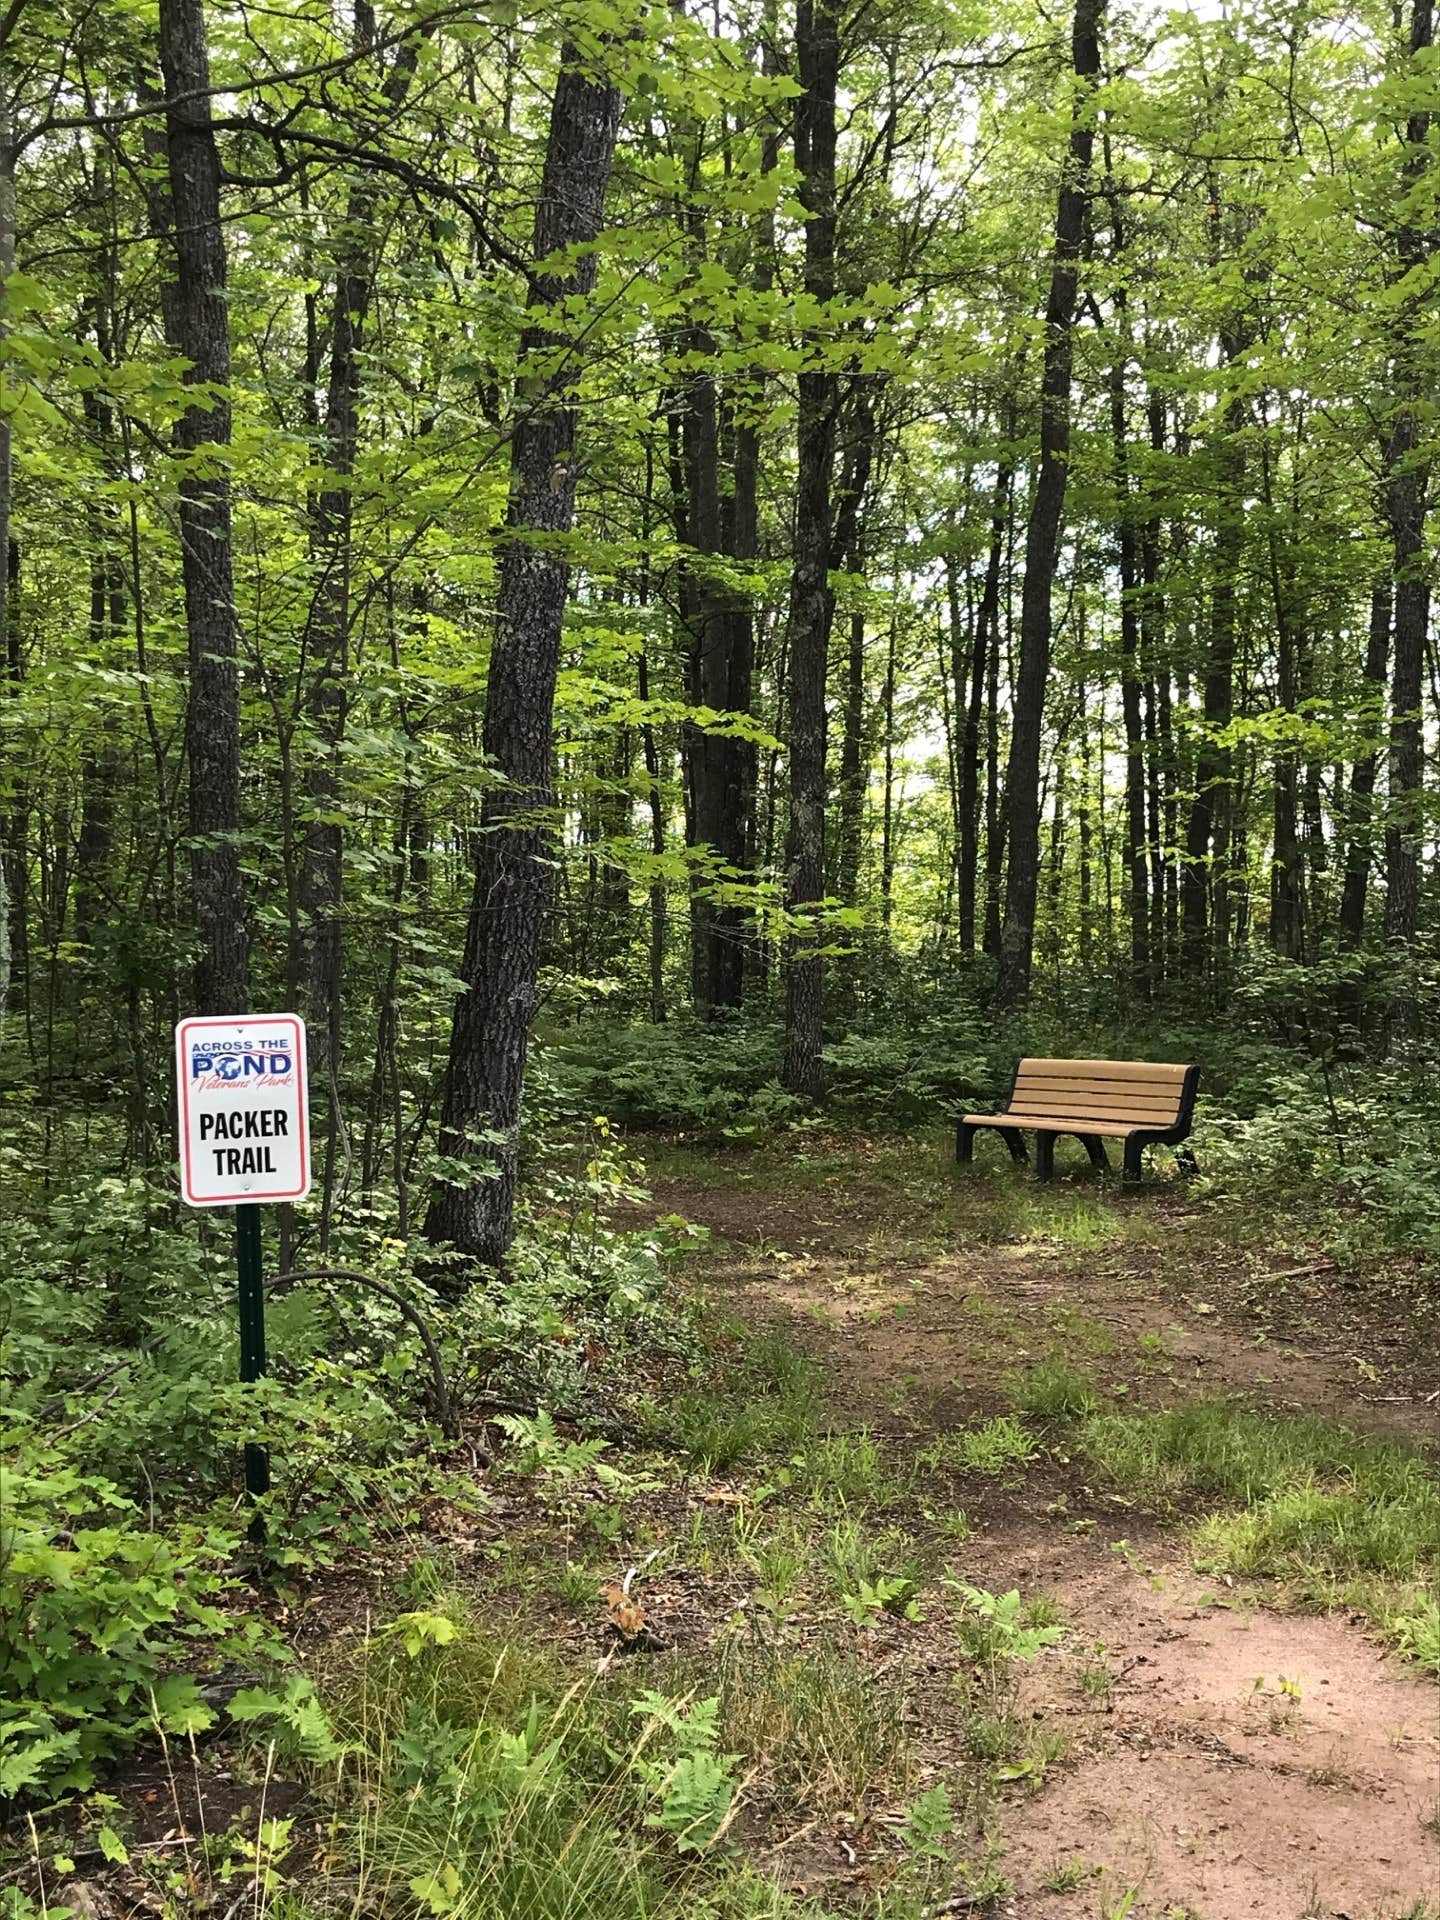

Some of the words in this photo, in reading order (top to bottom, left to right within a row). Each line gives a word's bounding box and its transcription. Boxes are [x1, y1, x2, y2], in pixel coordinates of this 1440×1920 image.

[192, 1040, 253, 1052] ACROSS
[259, 1039, 289, 1049] THE
[193, 1054, 292, 1080] POND
[191, 1075, 251, 1093] Veterans
[255, 1073, 294, 1088] Park
[200, 1109, 288, 1141] PACKER
[212, 1146, 277, 1176] TRAIL
